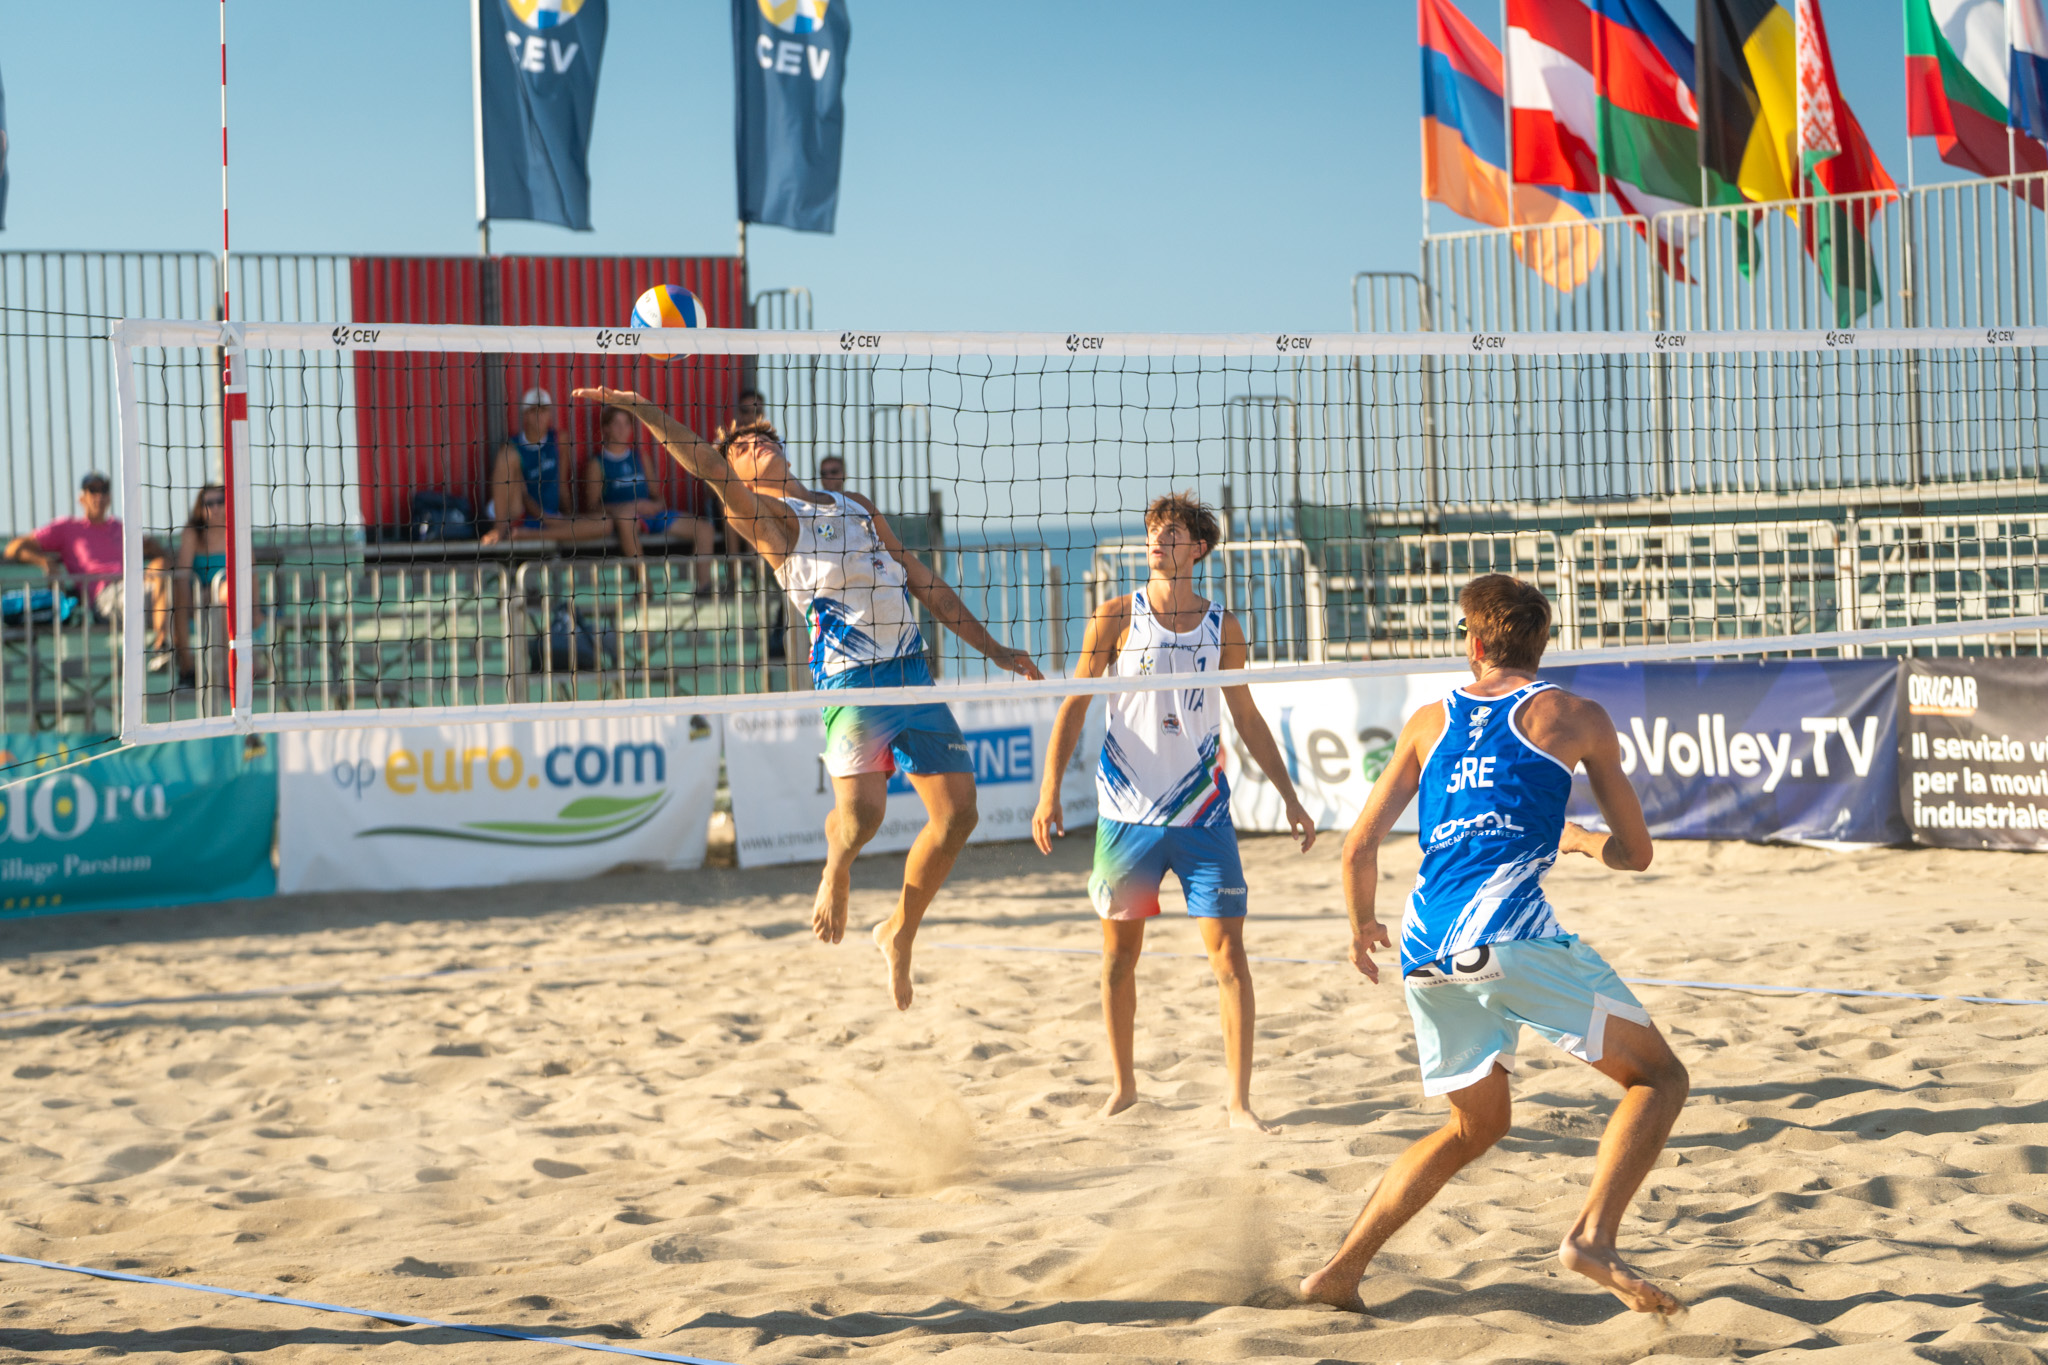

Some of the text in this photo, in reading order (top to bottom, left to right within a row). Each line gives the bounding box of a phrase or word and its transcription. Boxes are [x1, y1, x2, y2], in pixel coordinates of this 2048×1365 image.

[756, 34, 830, 81] CEV
[352, 329, 381, 343] CEV
[615, 333, 641, 346] CEV
[857, 335, 881, 348] CEV
[1082, 337, 1104, 349] CEV
[1291, 337, 1312, 349] CEV
[1486, 336, 1506, 348] CEV
[1668, 335, 1686, 347] CEV
[1837, 333, 1855, 345] CEV
[1998, 331, 2015, 342] CEV
[1197, 657, 1207, 672] 1
[1908, 673, 1979, 709] ORICAR
[1183, 688, 1205, 712] ITA
[1574, 713, 1880, 793] oVolley.TV
[1912, 732, 1929, 760] Il
[1932, 734, 2026, 763] servizio
[1446, 756, 1497, 794] GRE
[1913, 766, 2048, 799] per la movi
[1913, 800, 2048, 830] industriale
[1426, 835, 1462, 855] ECHNICAL
